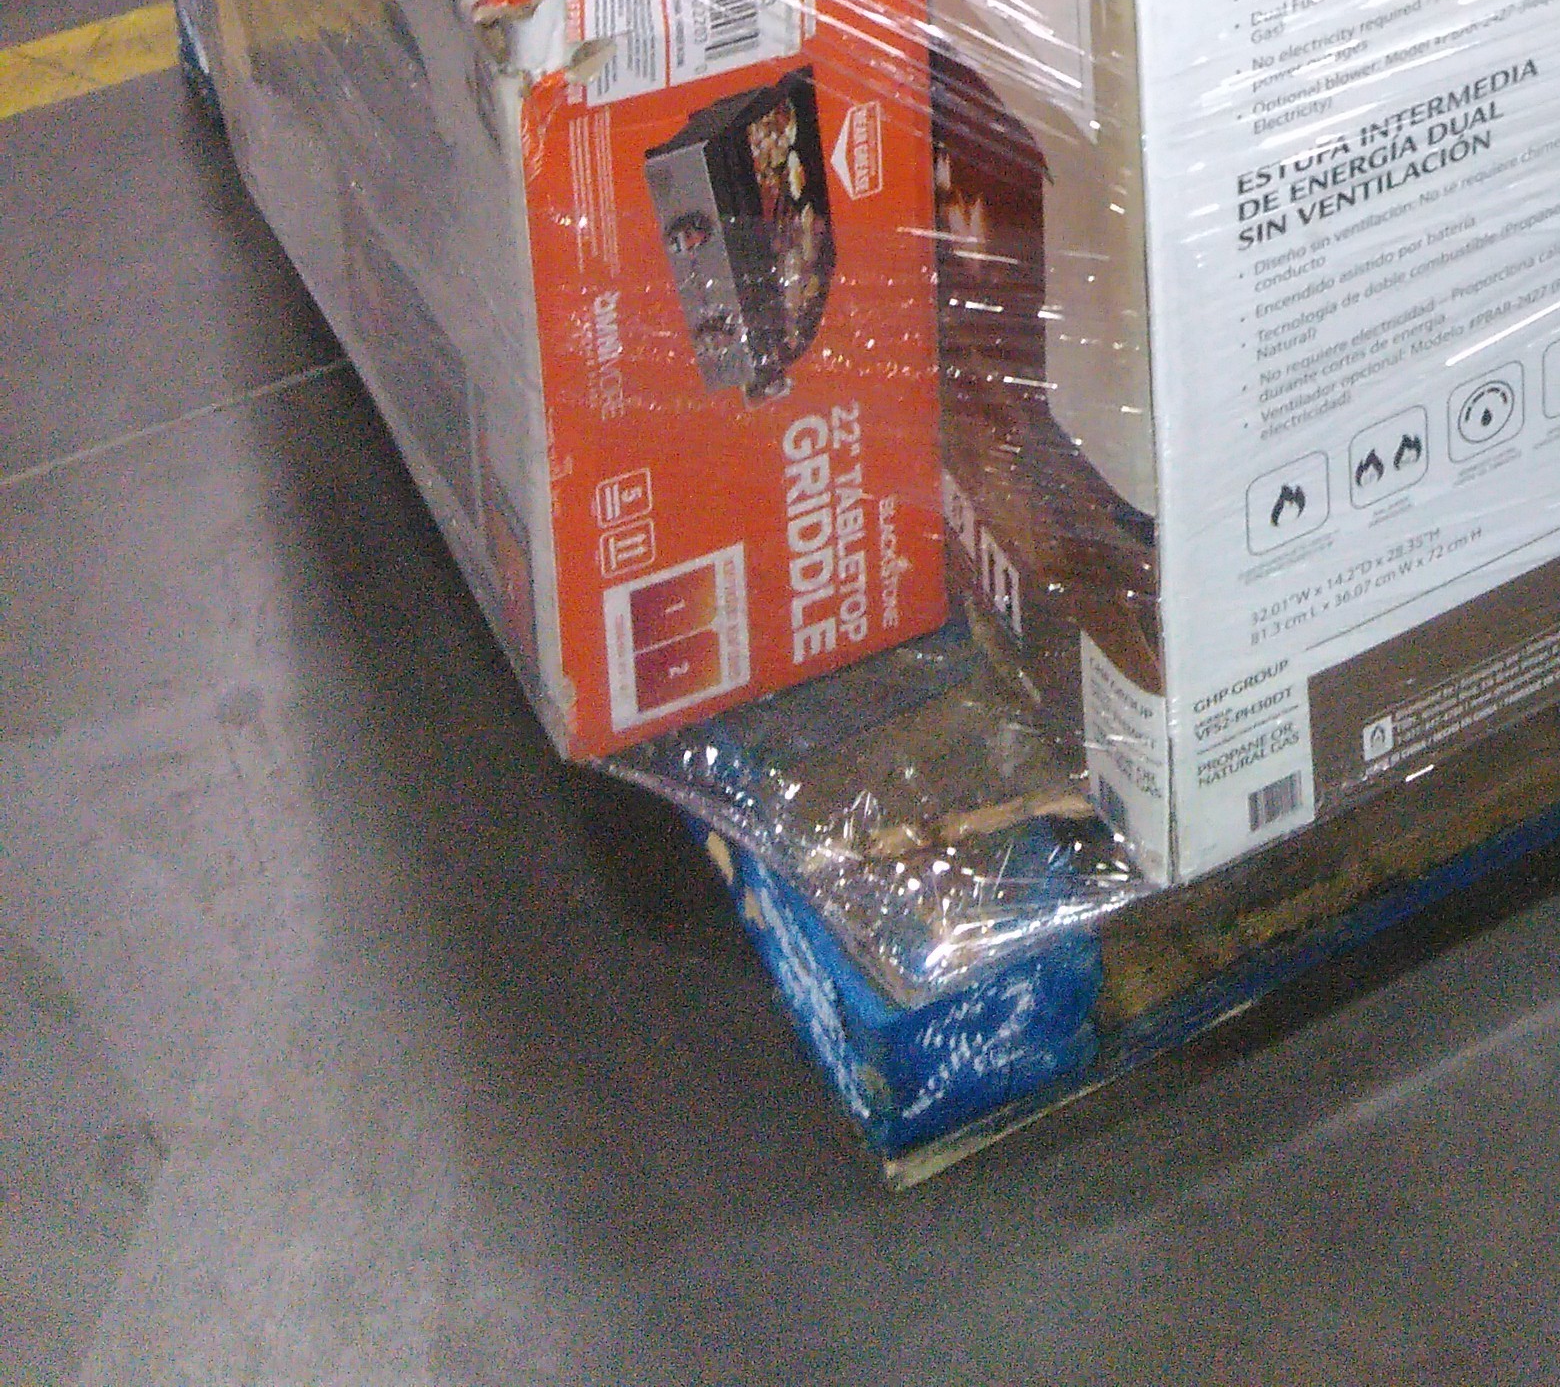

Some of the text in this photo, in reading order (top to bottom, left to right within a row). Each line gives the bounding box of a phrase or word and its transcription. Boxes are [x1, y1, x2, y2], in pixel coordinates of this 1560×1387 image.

[1251, 53, 1274, 72] No
[1278, 25, 1355, 64] electricity
[1359, 0, 1421, 34] required
[1359, 58, 1540, 148] INTERMEDIA
[1237, 99, 1505, 223] DE ENERGÍA DUAL
[1237, 128, 1492, 251] SIN VENTILACIÓN
[1253, 243, 1306, 275] Diseño
[1310, 233, 1330, 252] sin
[1419, 188, 1438, 206] No
[1341, 288, 1360, 308] de
[1364, 270, 1405, 298] doble
[1409, 232, 1495, 277] combustible
[1254, 254, 1326, 292] conducto
[1255, 275, 1335, 318] Encendido
[1339, 250, 1393, 282] asistido
[1398, 239, 1422, 261] por
[1256, 326, 1317, 362] Natural)
[1258, 367, 1318, 403] durante
[1322, 345, 1366, 375] cortes
[1370, 335, 1388, 354] de
[1259, 365, 1281, 385] No
[1285, 339, 1347, 376] requiere
[1351, 299, 1434, 344] electricidad
[1260, 380, 1335, 423] Ventilador
[1409, 322, 1463, 356] Modelo
[782, 413, 837, 665] GRIDDLE
[835, 466, 869, 643] TABLETOP
[1400, 559, 1414, 576] W
[1428, 547, 1444, 563] 72
[1448, 537, 1468, 554] cm
[1193, 659, 1290, 715] GHP GROUP
[1198, 734, 1266, 774] PROPANE
[1199, 730, 1300, 787] NATURAL GAS
